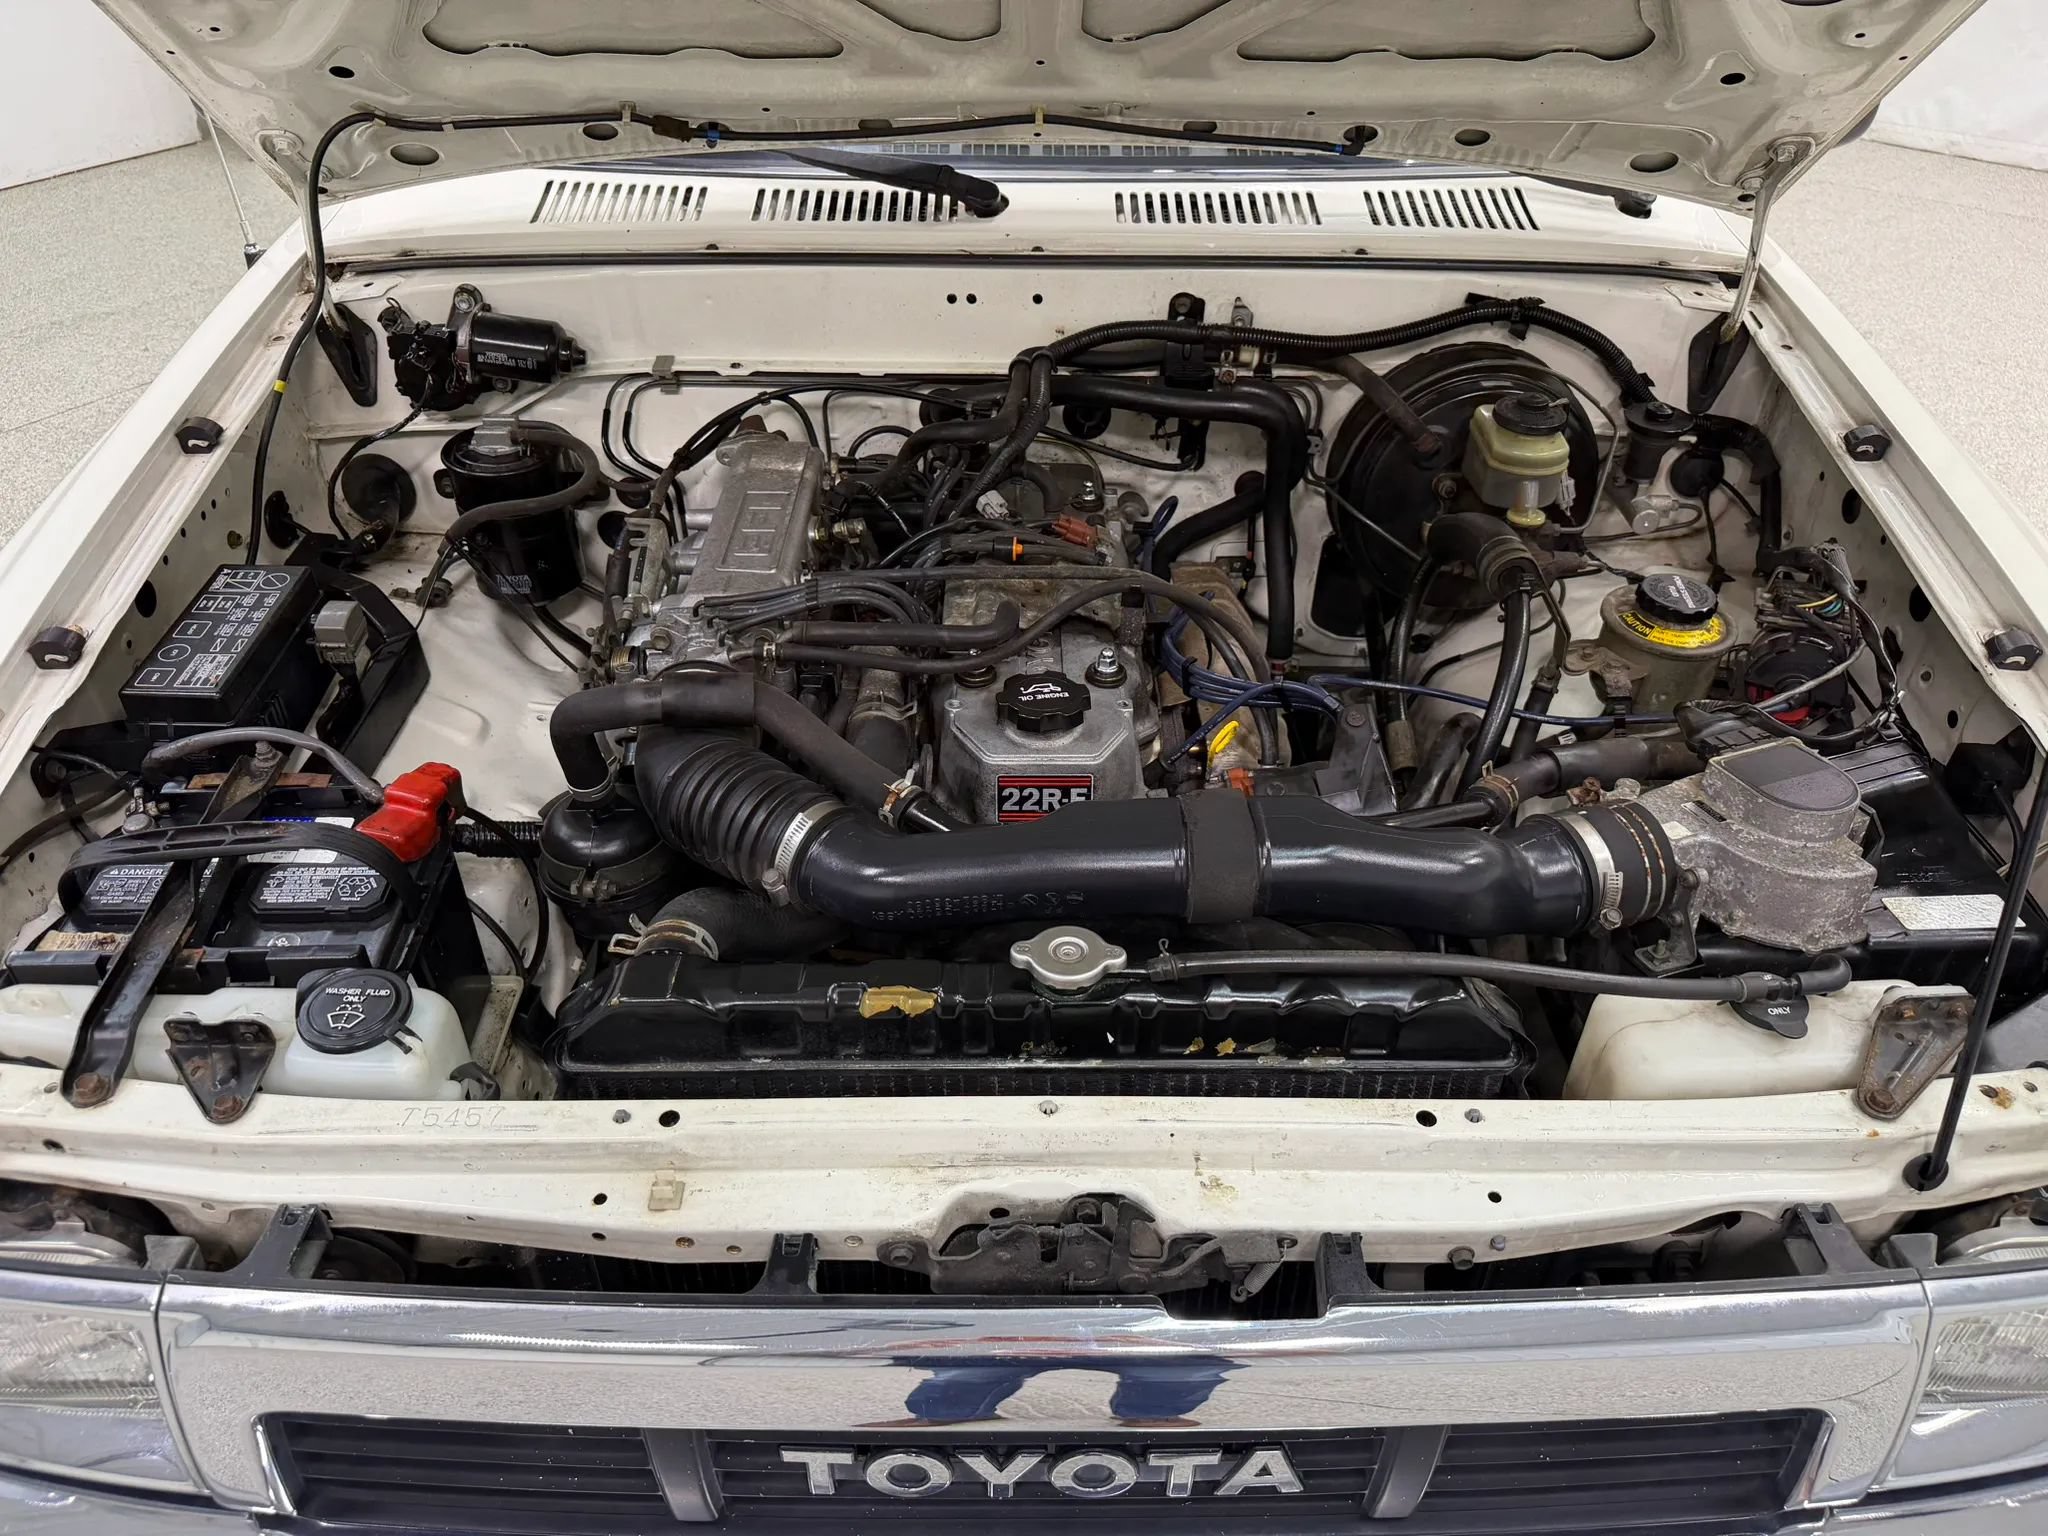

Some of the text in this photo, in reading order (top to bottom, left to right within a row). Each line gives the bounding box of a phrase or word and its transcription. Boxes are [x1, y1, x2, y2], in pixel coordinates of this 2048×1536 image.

[1621, 613, 1653, 637] CAUTION
[1018, 690, 1070, 702] ENGINE OIL
[120, 868, 164, 876] DANGER
[325, 987, 391, 997] WASHER FLUID
[343, 995, 366, 1003] ONLY
[1767, 1005, 1792, 1016] ONLY
[779, 1446, 1303, 1499] TOYOTA
